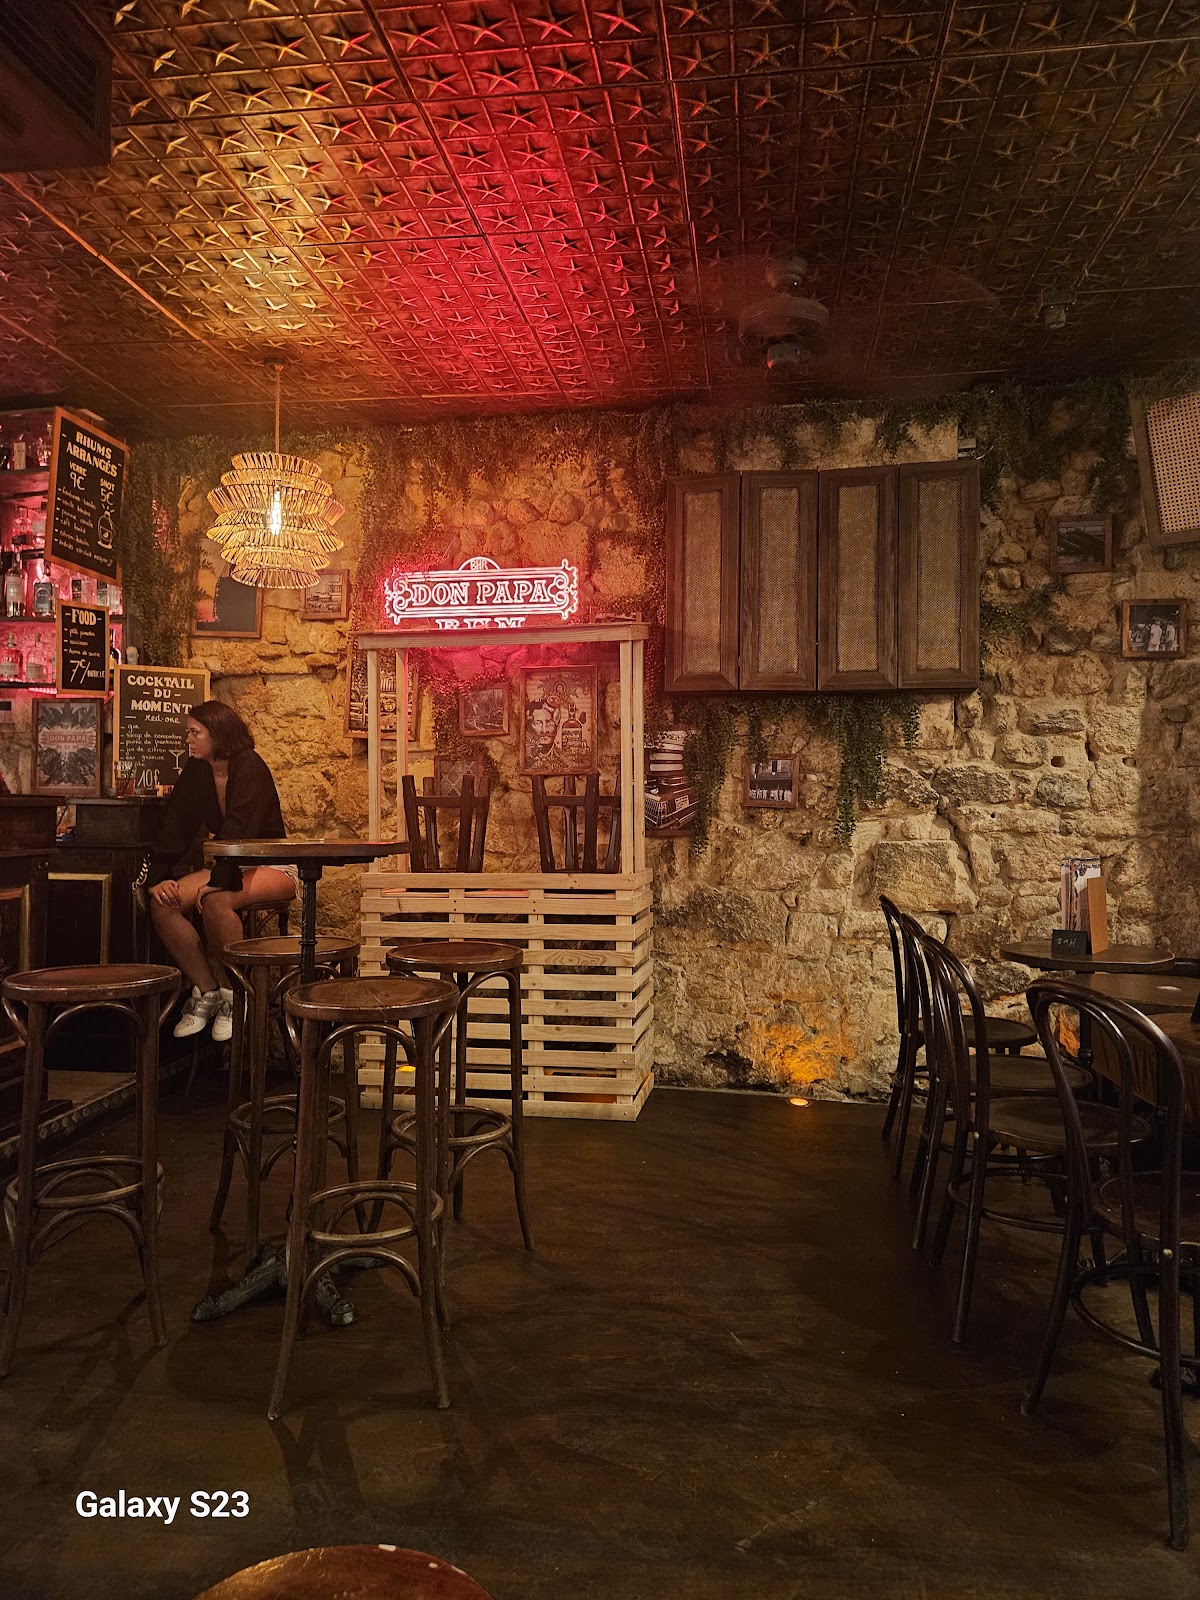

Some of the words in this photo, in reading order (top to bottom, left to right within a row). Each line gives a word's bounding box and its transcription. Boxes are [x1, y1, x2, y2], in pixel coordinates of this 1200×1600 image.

[76, 431, 112, 459] RHUMS
[66, 441, 118, 477] ARRANGÉS
[70, 461, 87, 476] VERRE
[100, 478, 115, 491] SHOT
[412, 582, 470, 606] DON
[477, 580, 550, 604] PAPA
[71, 608, 96, 625] FOOD
[127, 675, 195, 689] COCKTAIL
[153, 688, 171, 698] DU
[131, 700, 192, 715] MOMENT
